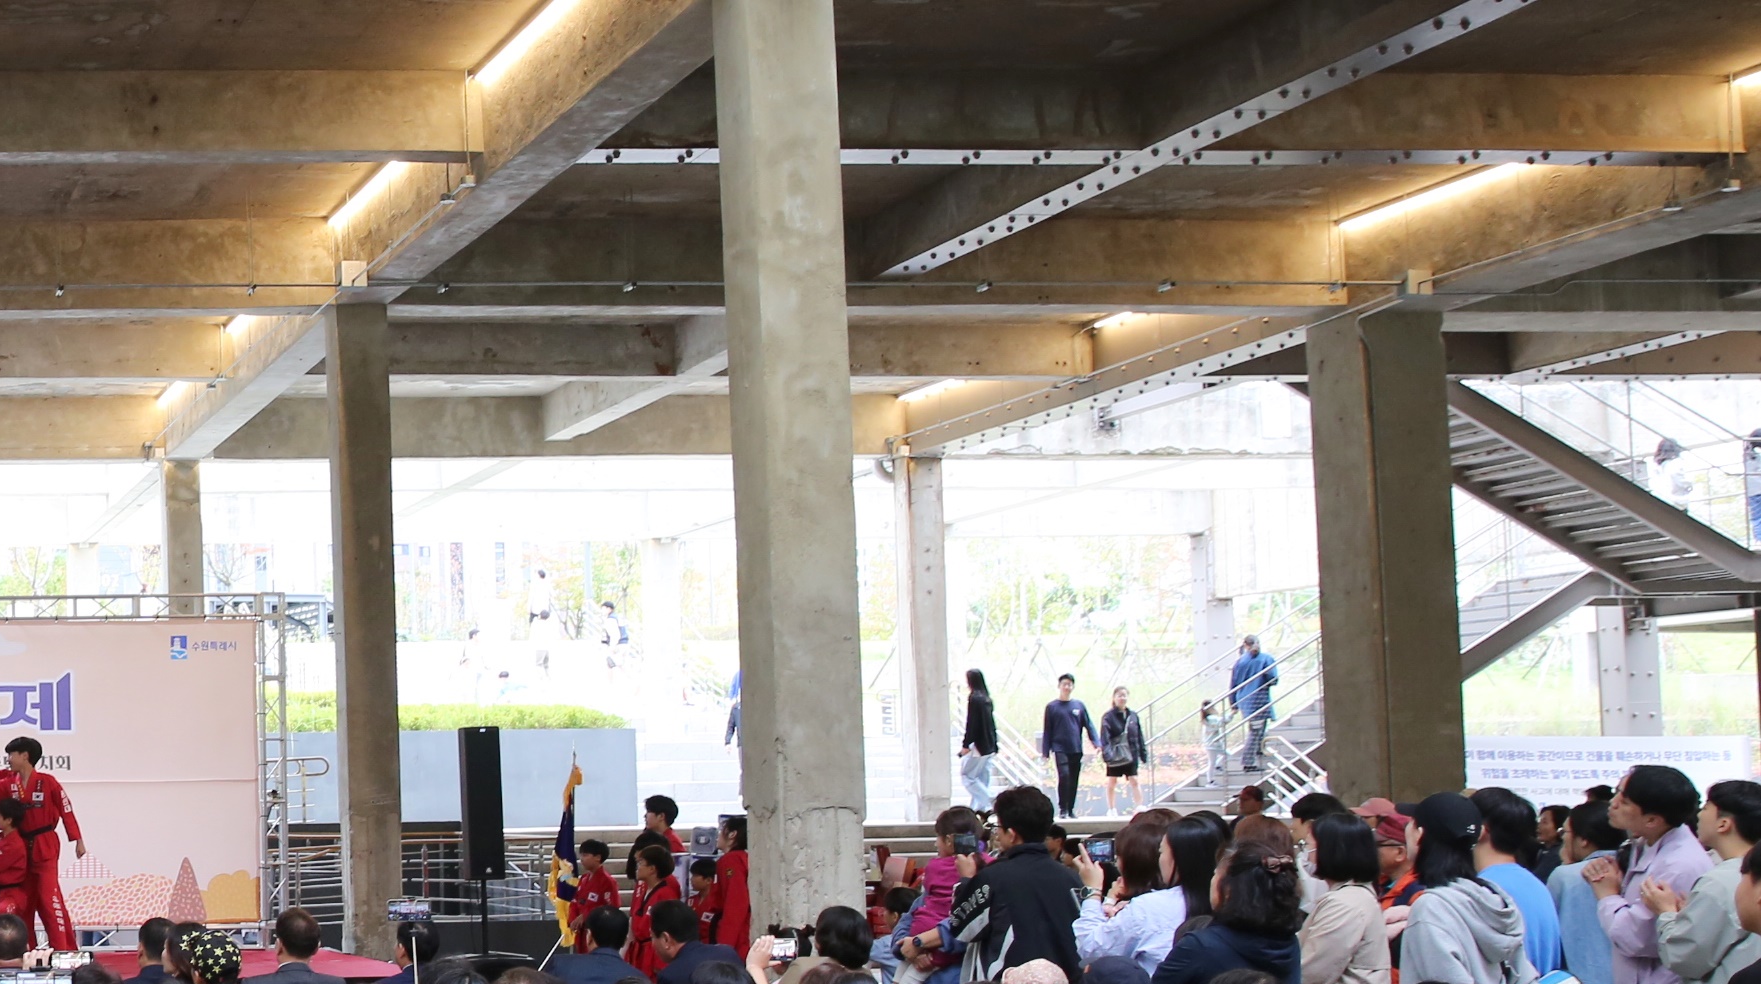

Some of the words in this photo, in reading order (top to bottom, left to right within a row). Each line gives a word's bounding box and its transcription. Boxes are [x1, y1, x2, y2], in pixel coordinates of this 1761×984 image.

[192, 640, 237, 651] 수원특례시
[1497, 750, 1535, 761] 이용하는
[1537, 750, 1584, 761] 공간이므로
[1586, 750, 1613, 761] 건물을
[1480, 768, 1509, 779] 위험을
